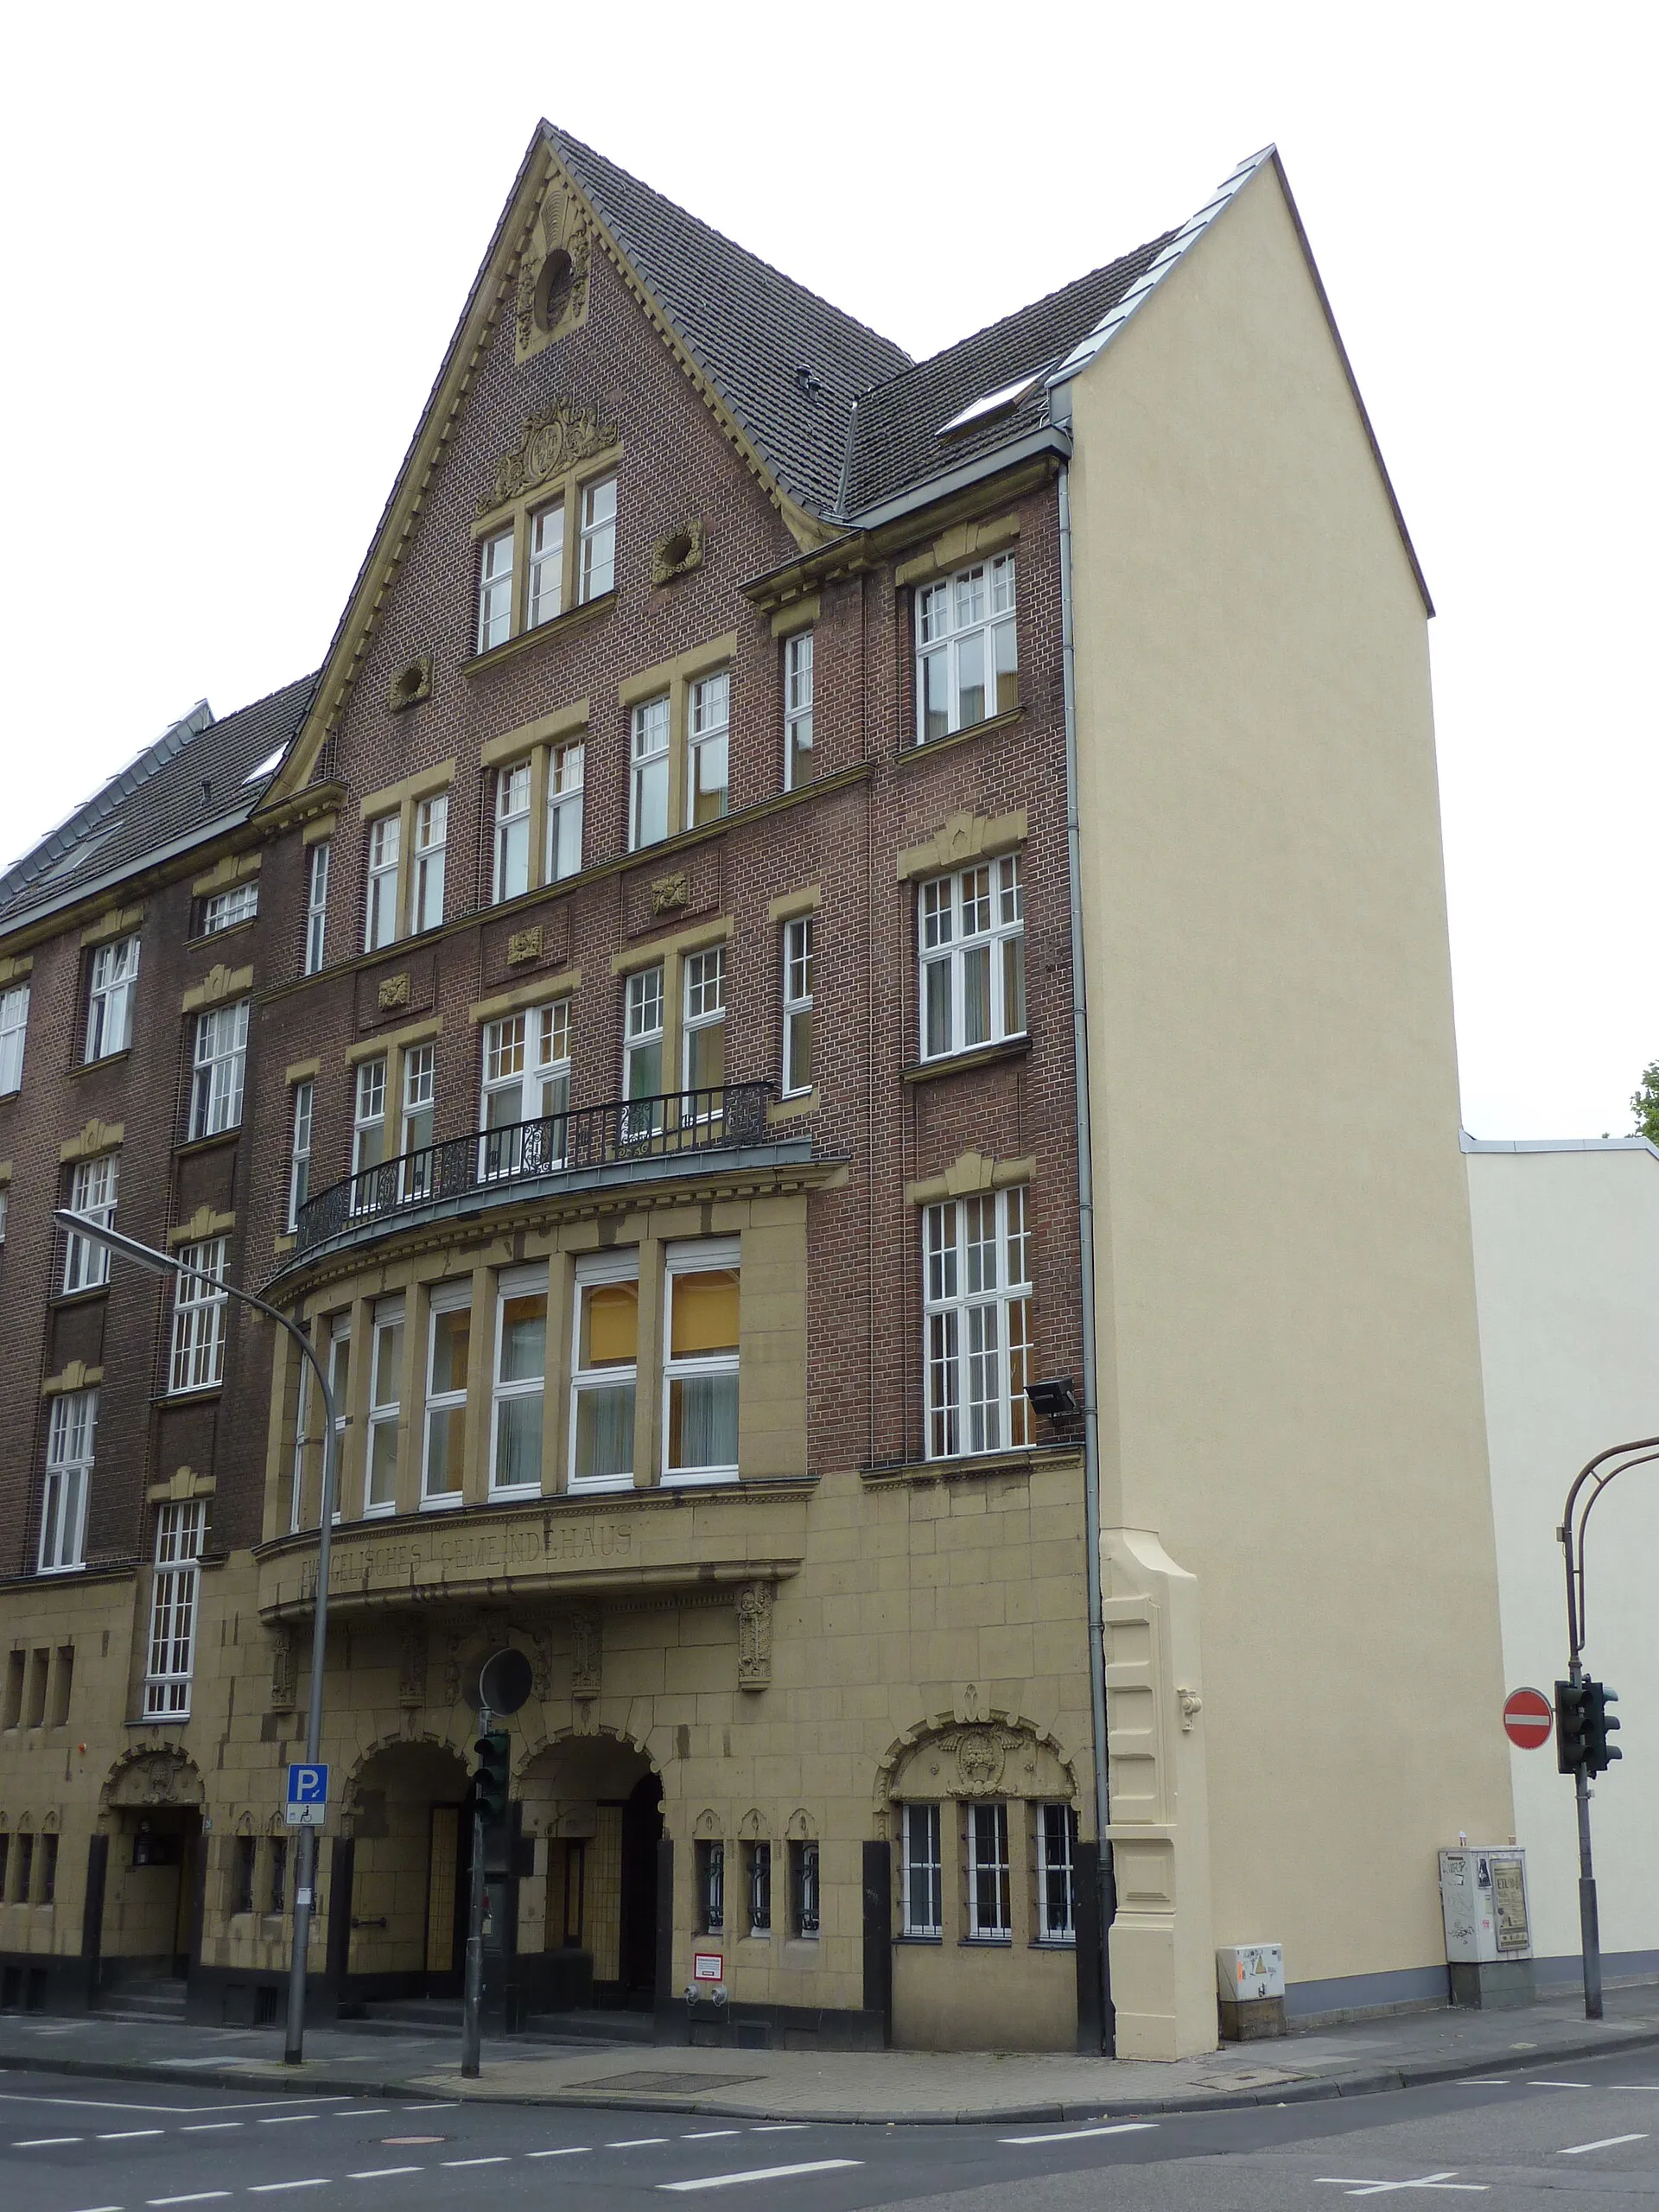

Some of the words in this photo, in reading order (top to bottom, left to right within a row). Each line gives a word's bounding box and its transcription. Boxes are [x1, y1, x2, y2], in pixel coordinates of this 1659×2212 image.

[301, 1543, 422, 1588] EVAGELISCHES
[441, 1523, 632, 1570] GEMEINDEHAUS
[296, 1769, 319, 1801] P
